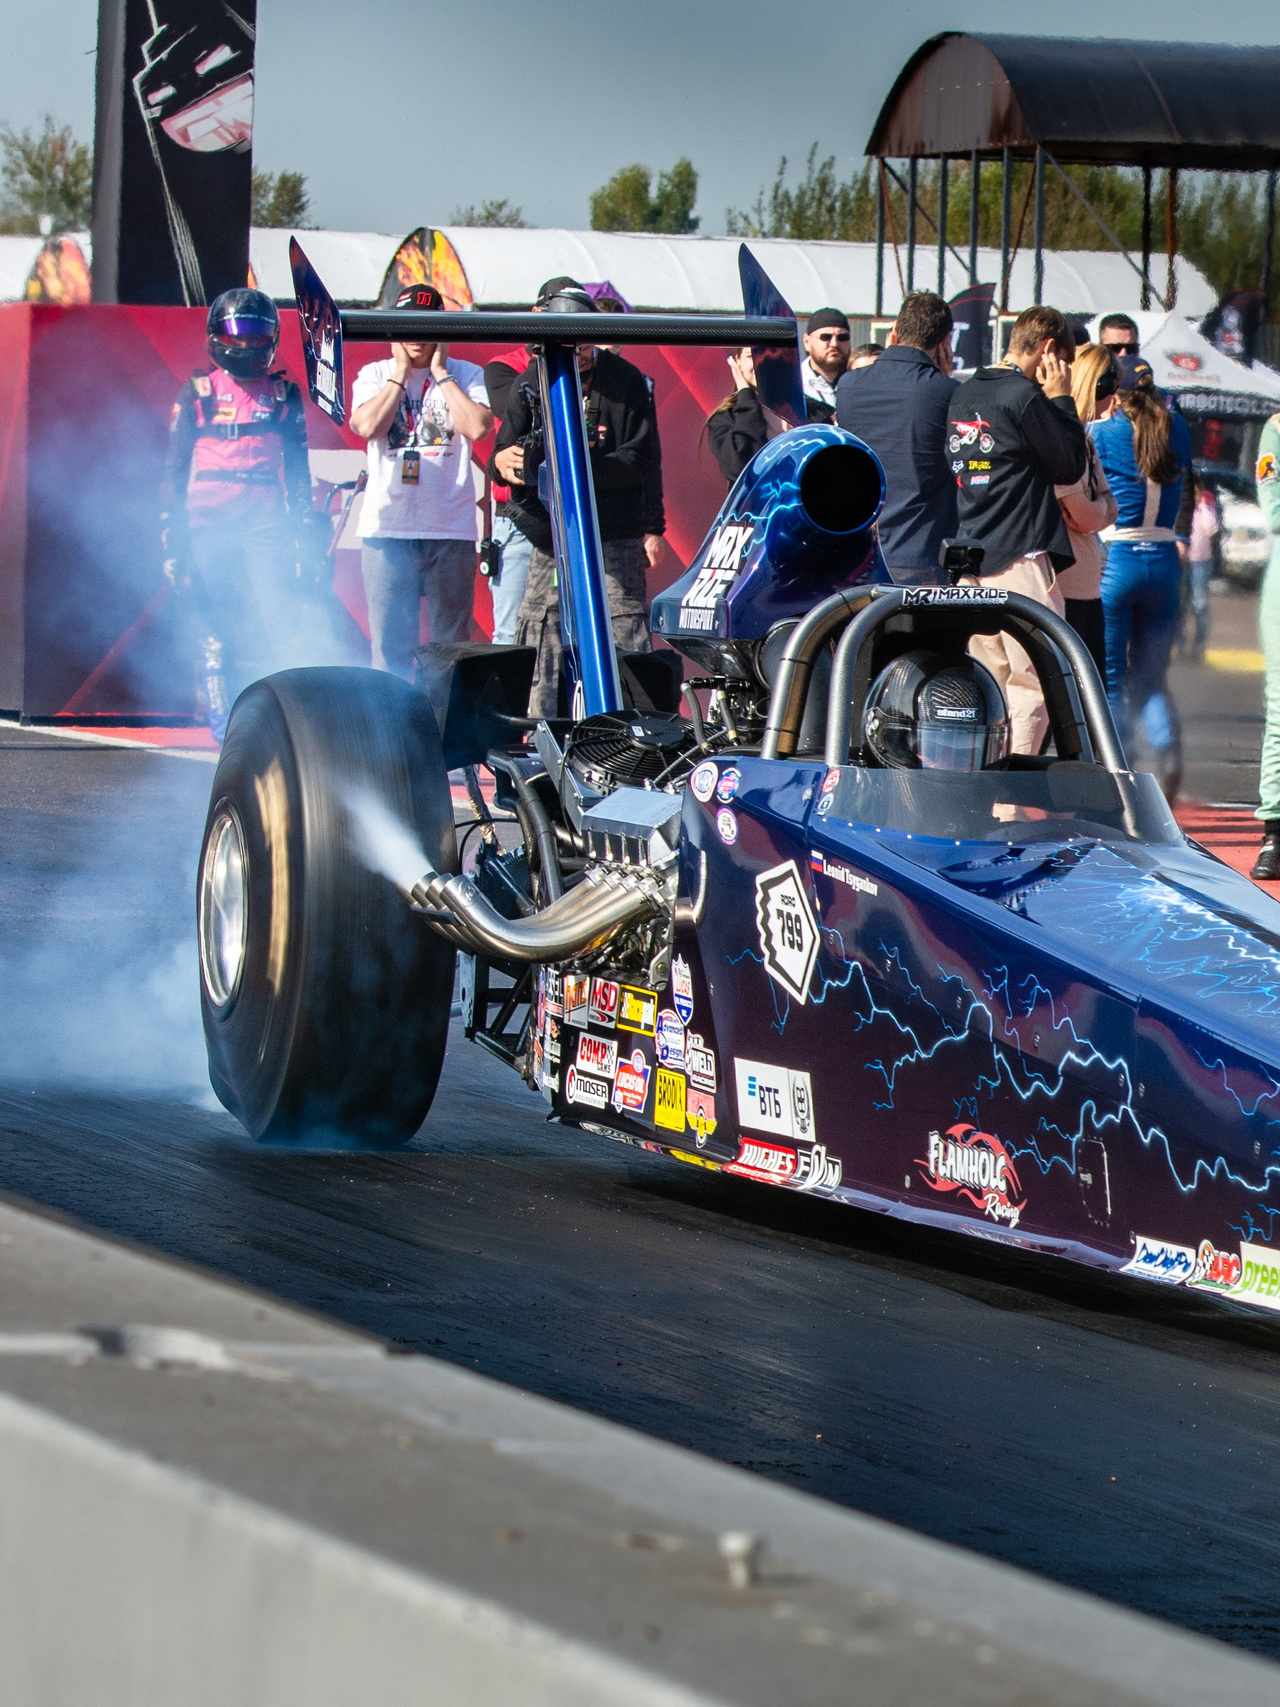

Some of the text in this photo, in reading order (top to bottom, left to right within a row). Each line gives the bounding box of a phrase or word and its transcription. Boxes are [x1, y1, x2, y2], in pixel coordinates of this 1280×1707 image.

[679, 608, 714, 630] MOTORSPORT
[823, 860, 878, 896] Leonid Tsygankov
[776, 908, 803, 952] 799
[591, 981, 618, 1012] MSD
[580, 1037, 606, 1064] COMP
[597, 1061, 611, 1073] CAMS
[576, 1078, 608, 1099] MOSER
[658, 1074, 683, 1112] BRODIX
[758, 1085, 782, 1119] ВТБ
[737, 1143, 796, 1175] HUGHES
[983, 1193, 1020, 1229] Racing
